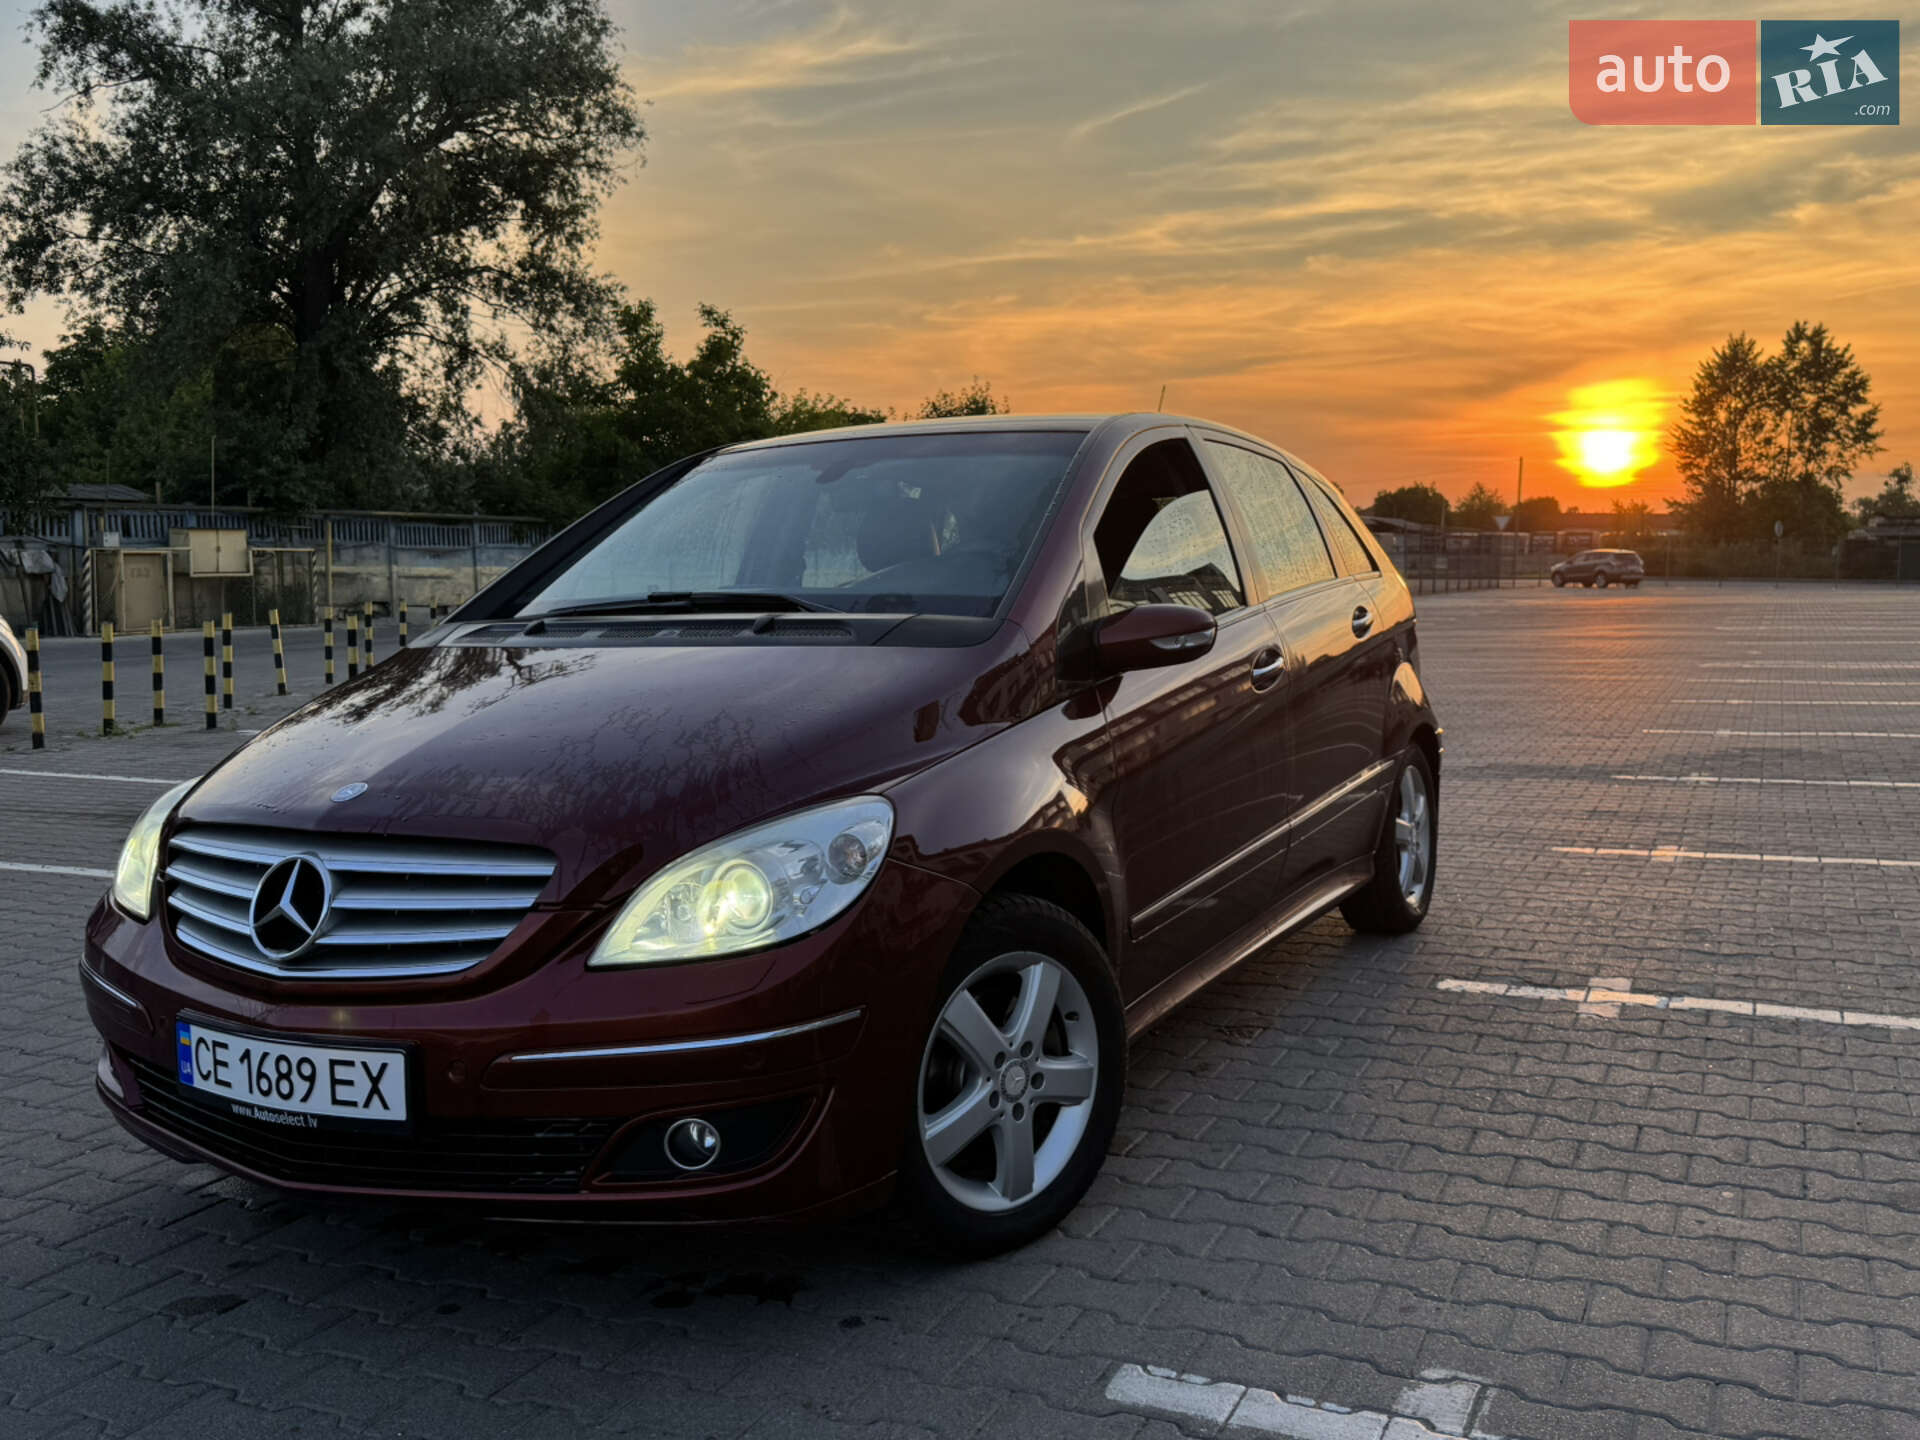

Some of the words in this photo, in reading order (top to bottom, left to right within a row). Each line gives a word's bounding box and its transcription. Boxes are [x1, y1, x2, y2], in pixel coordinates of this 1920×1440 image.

[195, 1037, 232, 1088] CE
[239, 1048, 317, 1103] 1689
[329, 1058, 390, 1110] EX
